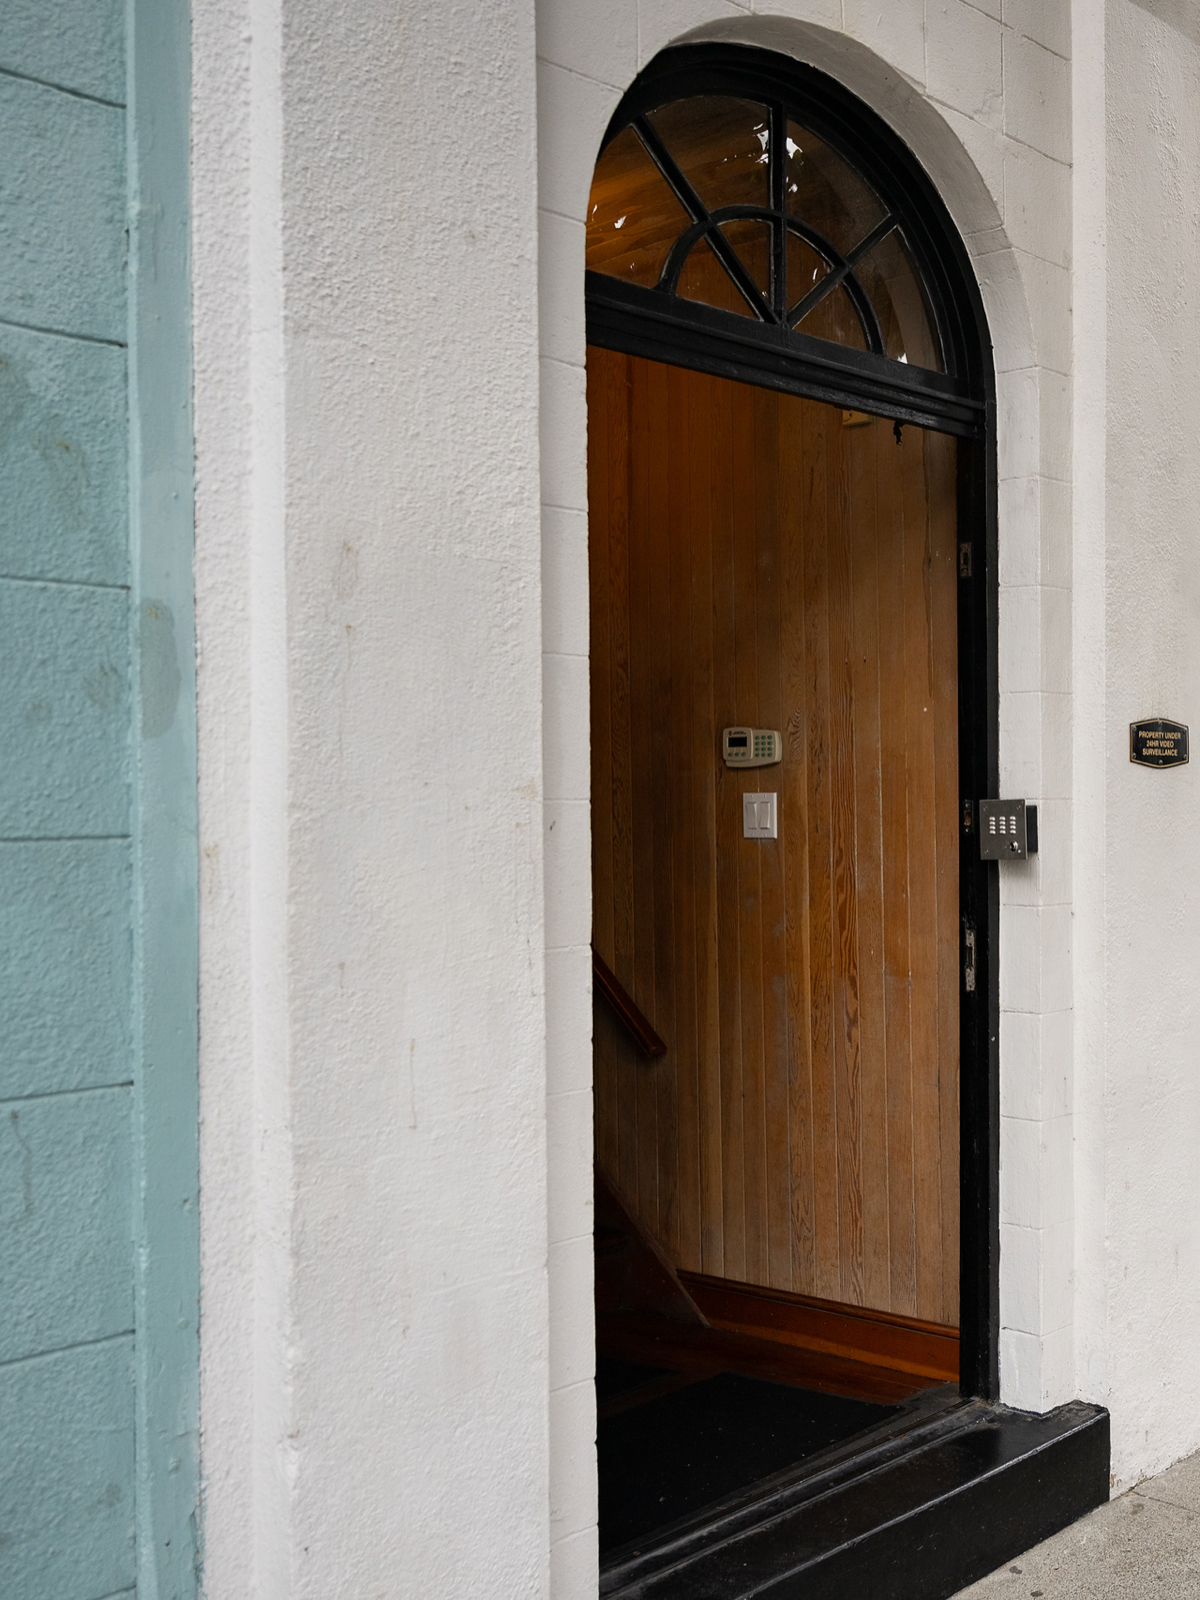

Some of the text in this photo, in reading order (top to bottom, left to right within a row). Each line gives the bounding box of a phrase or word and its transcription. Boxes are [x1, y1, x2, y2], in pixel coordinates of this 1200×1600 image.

[1138, 730, 1181, 740] PROPERTY UNDER
[1146, 740, 1174, 748] 24HR VIDEO
[1142, 748, 1178, 756] SURVEILLANCE
